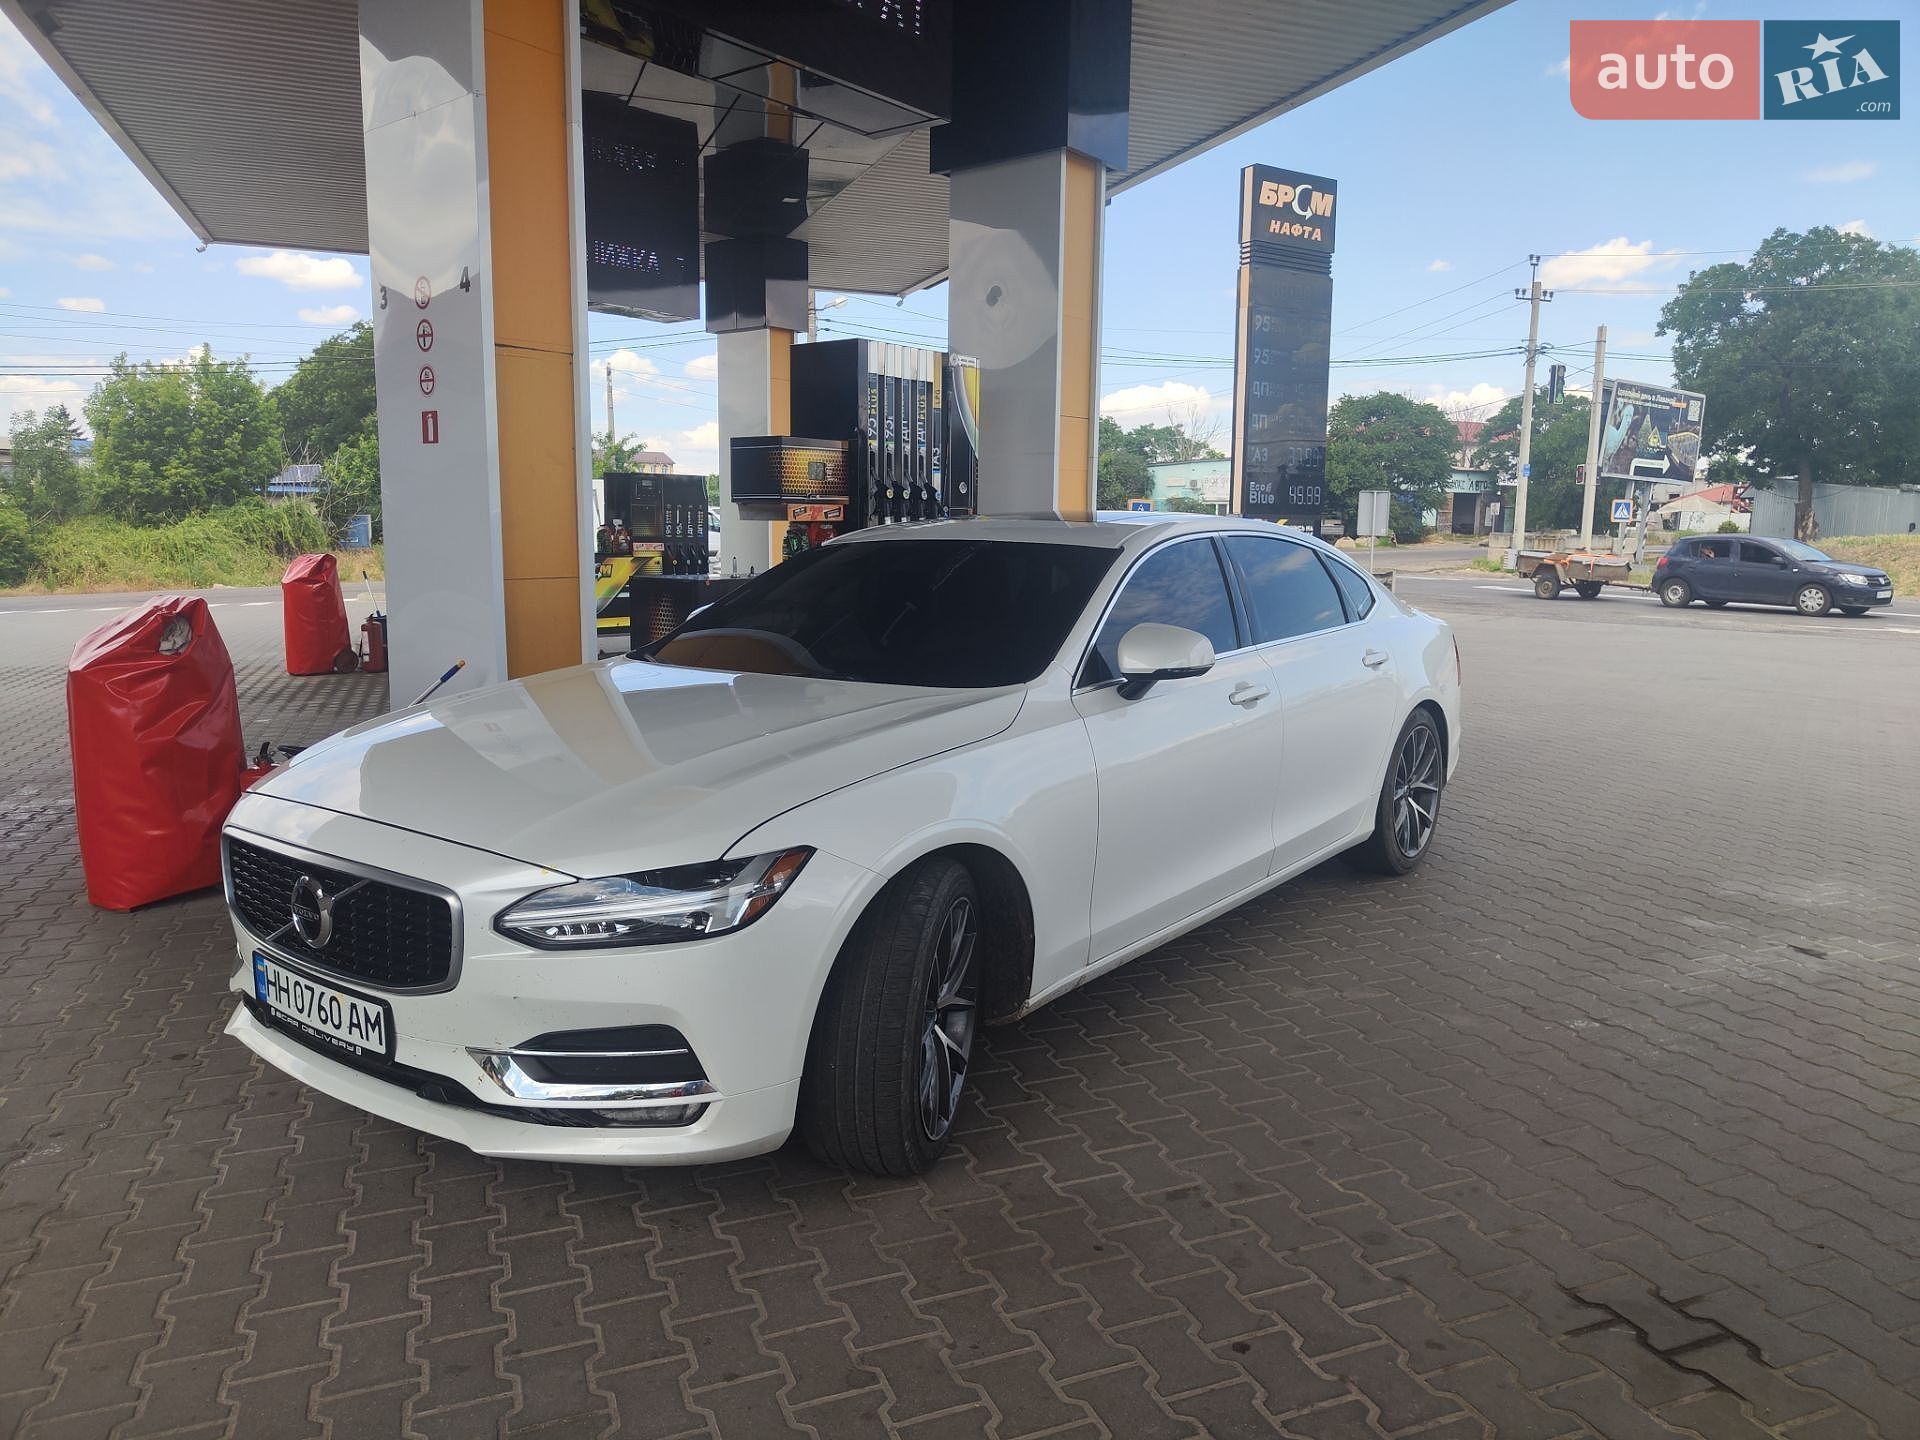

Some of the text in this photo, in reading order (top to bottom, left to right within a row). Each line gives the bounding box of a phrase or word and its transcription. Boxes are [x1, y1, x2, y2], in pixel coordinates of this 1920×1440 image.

[1258, 180, 1334, 220] БРСМ
[1269, 219, 1323, 242] НАФТА
[460, 266, 471, 293] 4
[380, 286, 388, 310] 3
[1254, 315, 1271, 332] 95
[1253, 348, 1270, 366] 95
[1249, 481, 1266, 492] Eco
[1249, 491, 1275, 504] Blue
